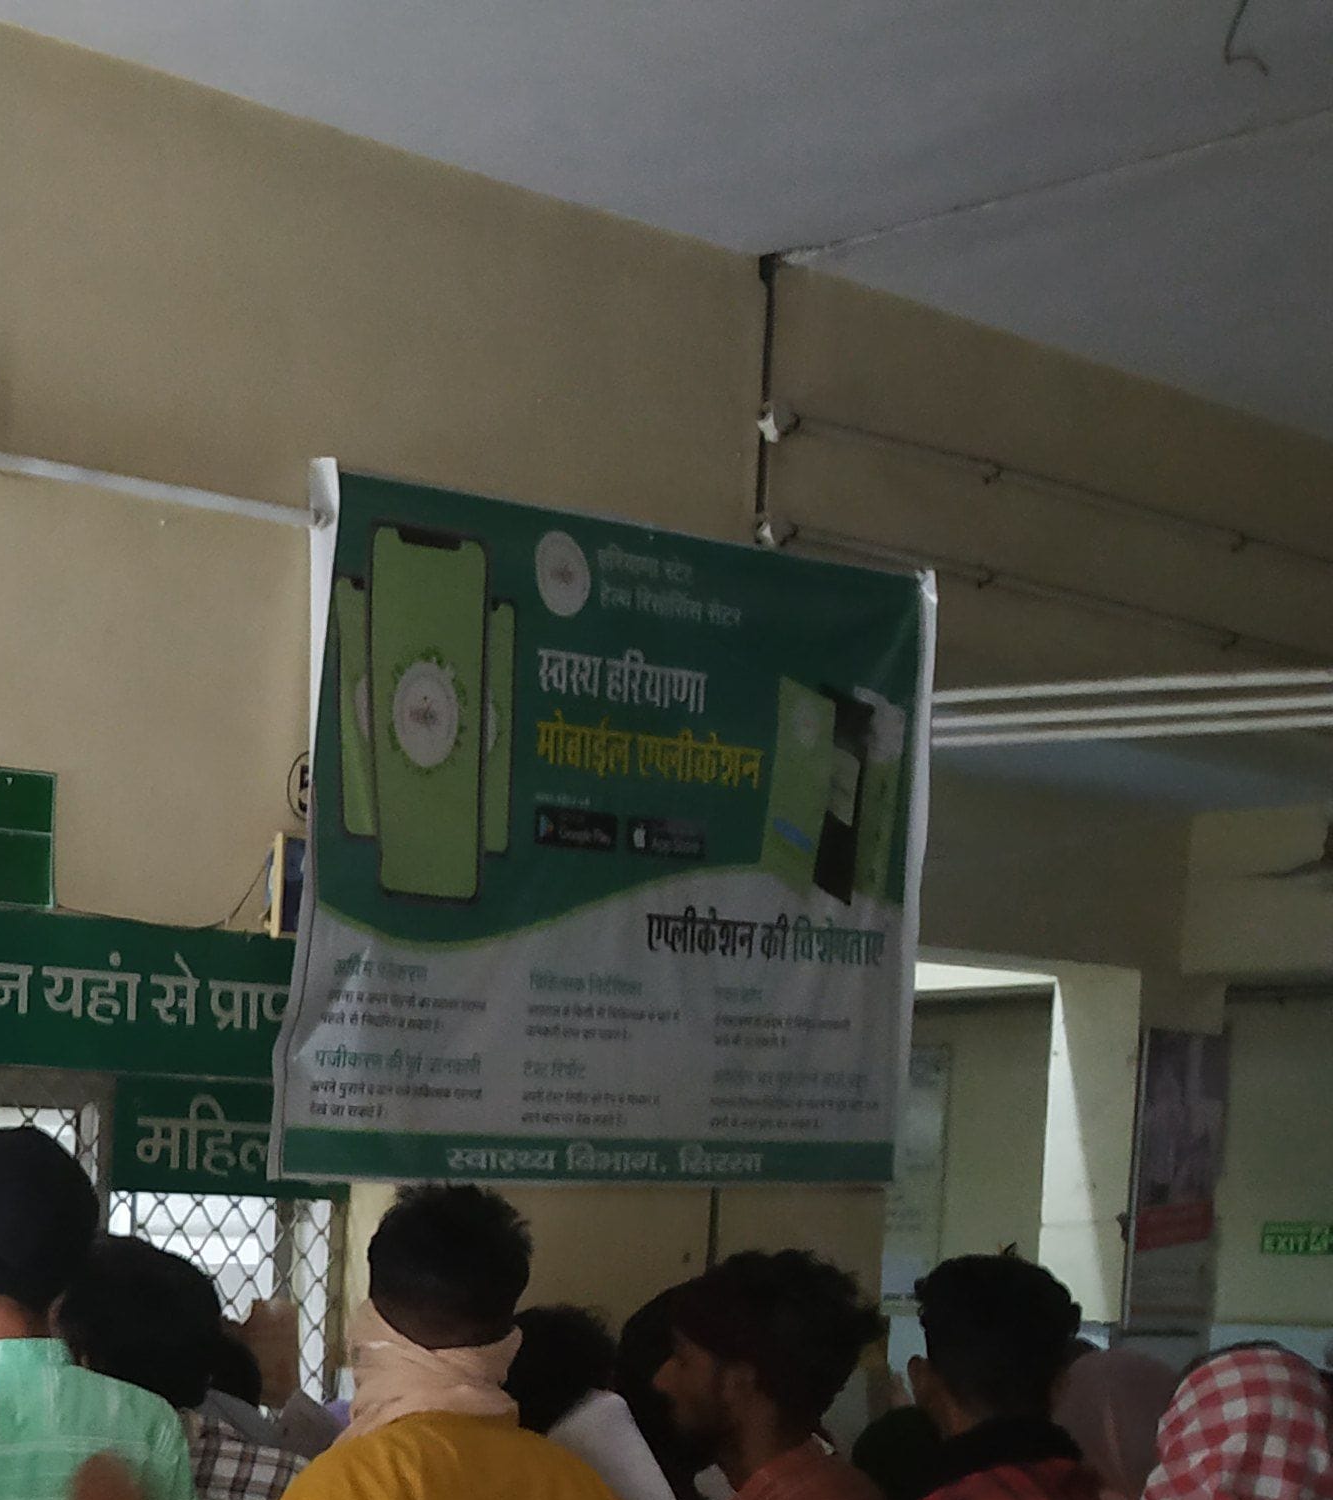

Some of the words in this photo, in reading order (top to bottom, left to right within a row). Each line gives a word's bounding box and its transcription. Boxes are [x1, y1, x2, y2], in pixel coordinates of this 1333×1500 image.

[605, 648, 709, 714] हरियाणा
[646, 904, 757, 957] एप्लीकेशन
[758, 912, 789, 961] की
[41, 950, 140, 1022] यहां
[149, 953, 199, 1029] से
[1263, 1234, 1307, 1253] EXIT
